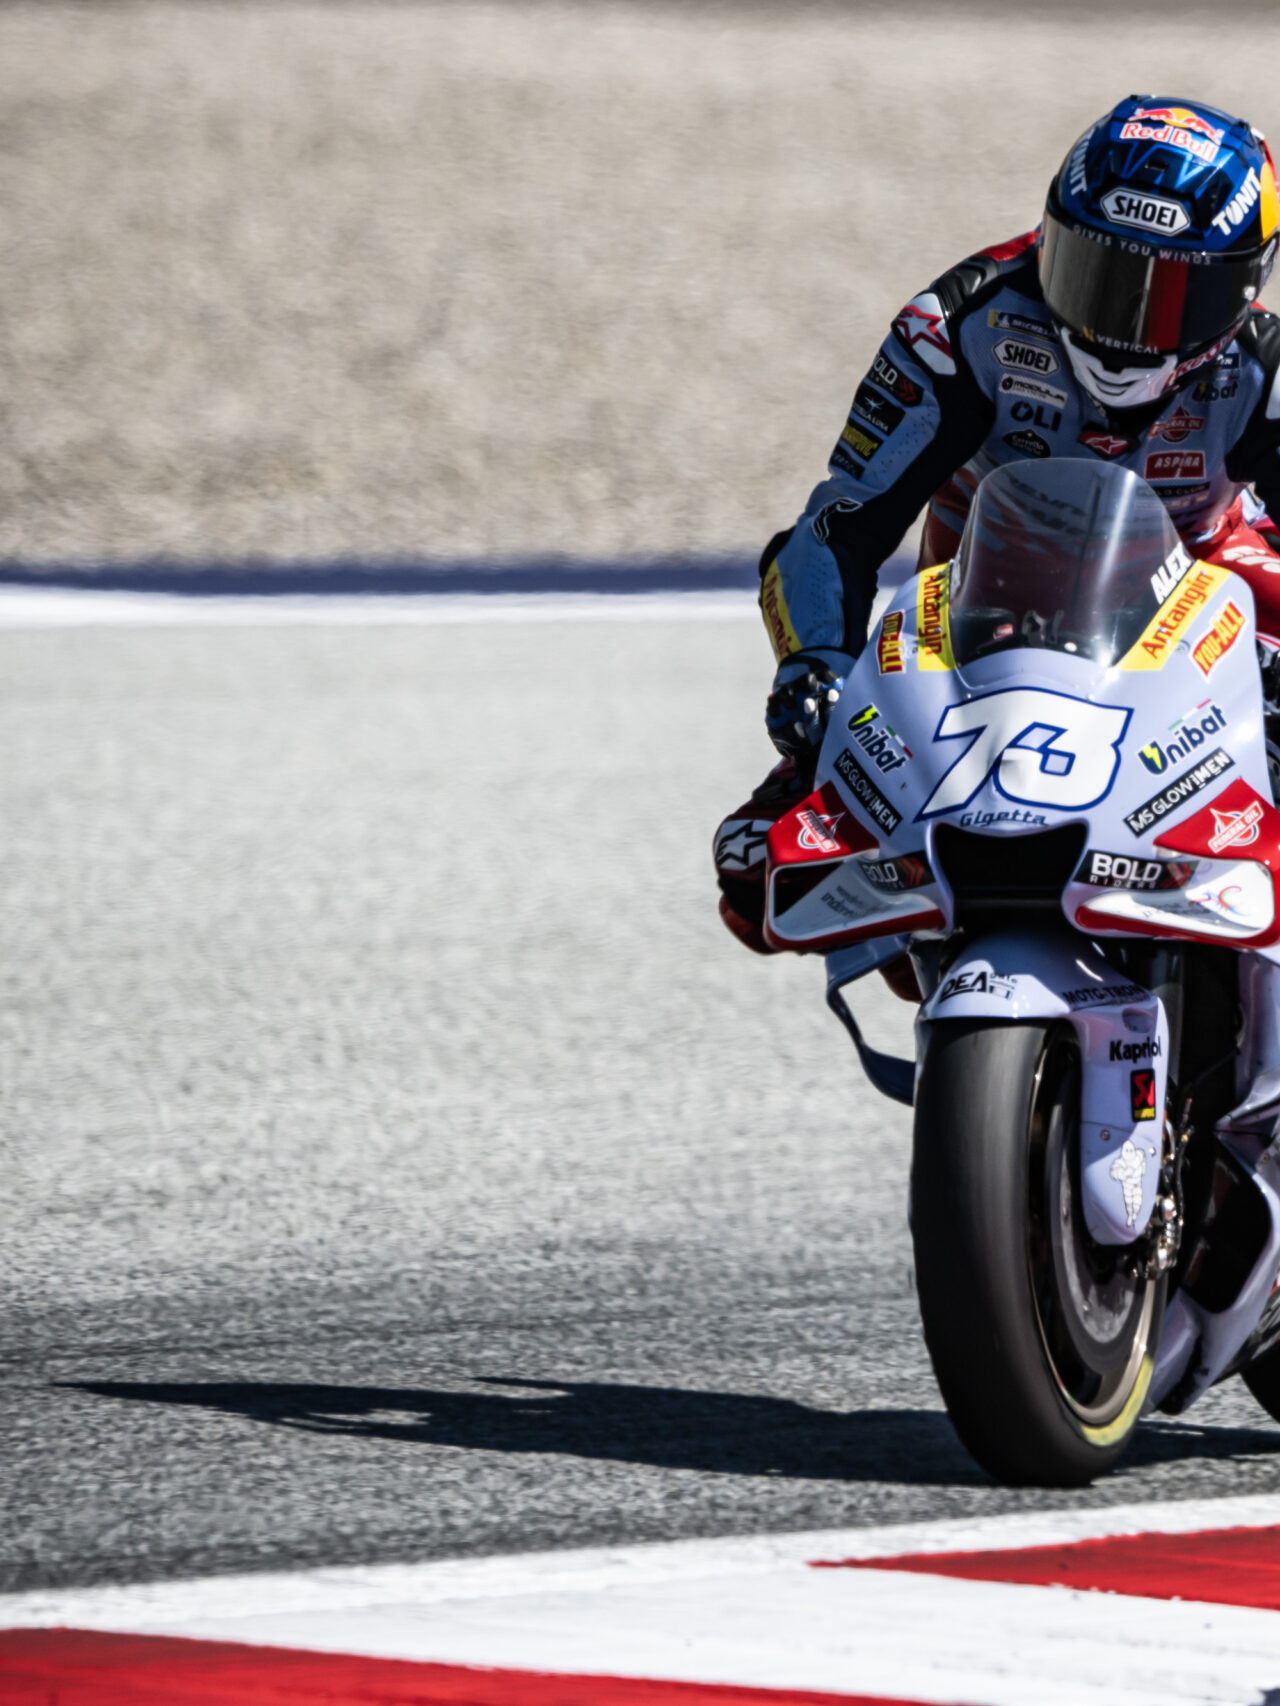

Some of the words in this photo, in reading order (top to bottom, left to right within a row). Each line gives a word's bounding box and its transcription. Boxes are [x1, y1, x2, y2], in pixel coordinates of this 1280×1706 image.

[1119, 122, 1170, 141] Red
[1169, 128, 1217, 162] Bull
[1112, 195, 1177, 228] SHOEI
[1073, 225, 1112, 246] GIVES
[1119, 241, 1150, 257] YOU
[1159, 250, 1212, 265] WINGS
[1002, 344, 1050, 372] SHOEI
[1096, 335, 1160, 354] VERTICAL
[1010, 402, 1062, 432] OLI
[1151, 541, 1192, 605] ALEX
[919, 569, 946, 656] Antangin
[1141, 571, 1215, 660] Antangin
[1194, 602, 1246, 672] YOU-ALL
[848, 704, 906, 773] Unibat
[912, 686, 1135, 824] 73
[1138, 704, 1227, 775] Unibat
[960, 809, 1047, 827] Gigetta
[1128, 806, 1155, 833] MS
[1151, 778, 1195, 817] GLOW
[1091, 852, 1162, 882] BOLD
[1110, 1036, 1162, 1063] Kapriol
